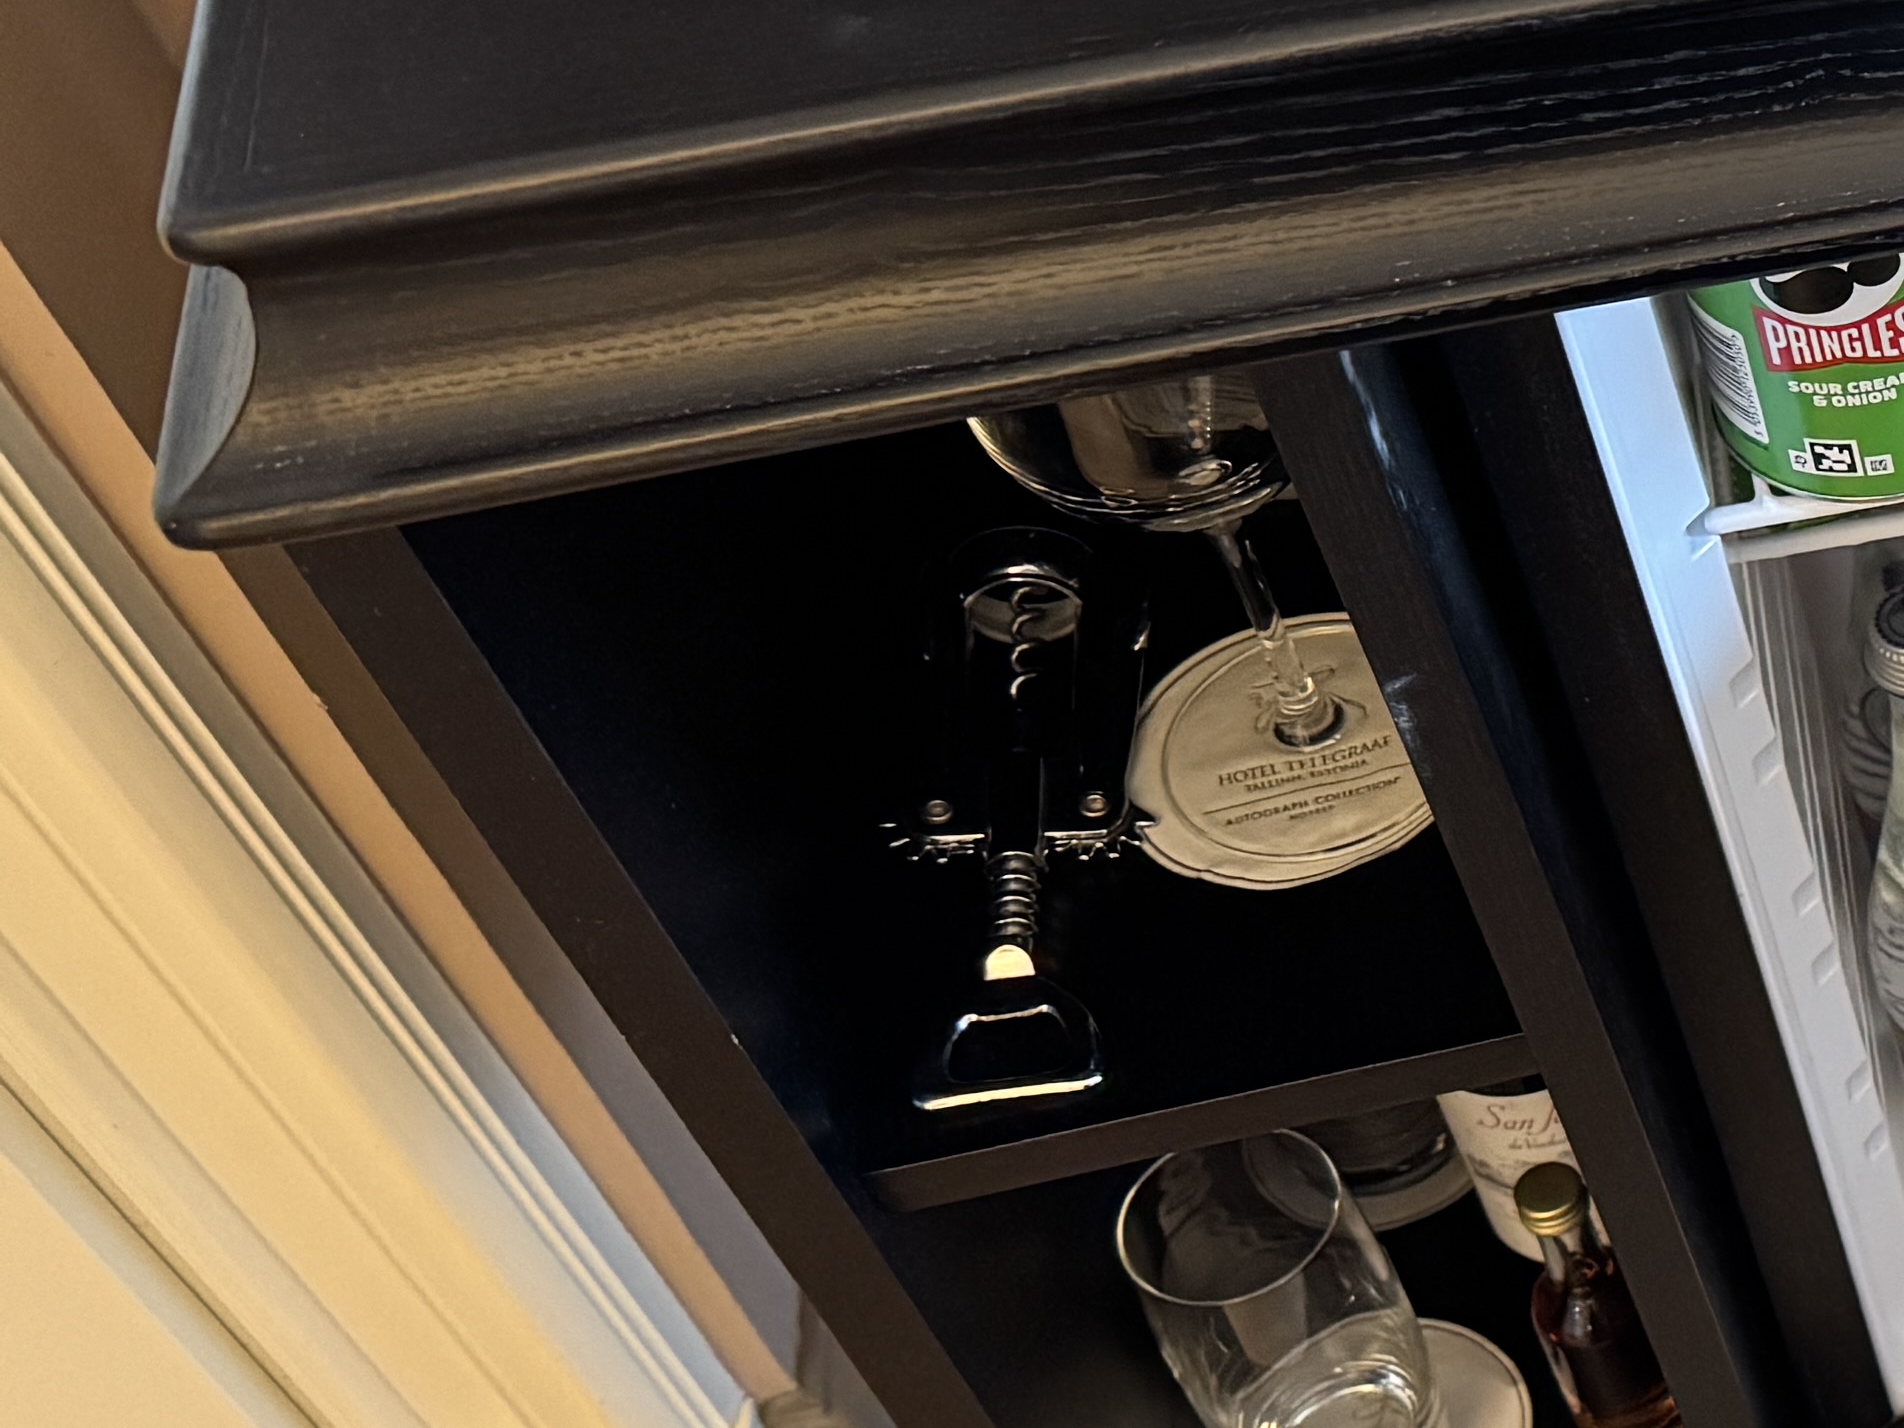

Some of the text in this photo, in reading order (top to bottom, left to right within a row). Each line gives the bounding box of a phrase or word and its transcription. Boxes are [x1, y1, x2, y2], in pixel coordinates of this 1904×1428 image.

[1787, 380, 1843, 395] SOUR
[1812, 387, 1898, 408] & ONION
[1218, 734, 1392, 787] HOTEL TELEGRAAF
[1224, 800, 1311, 826] AUTOGRAPH
[1476, 1103, 1535, 1131] San
